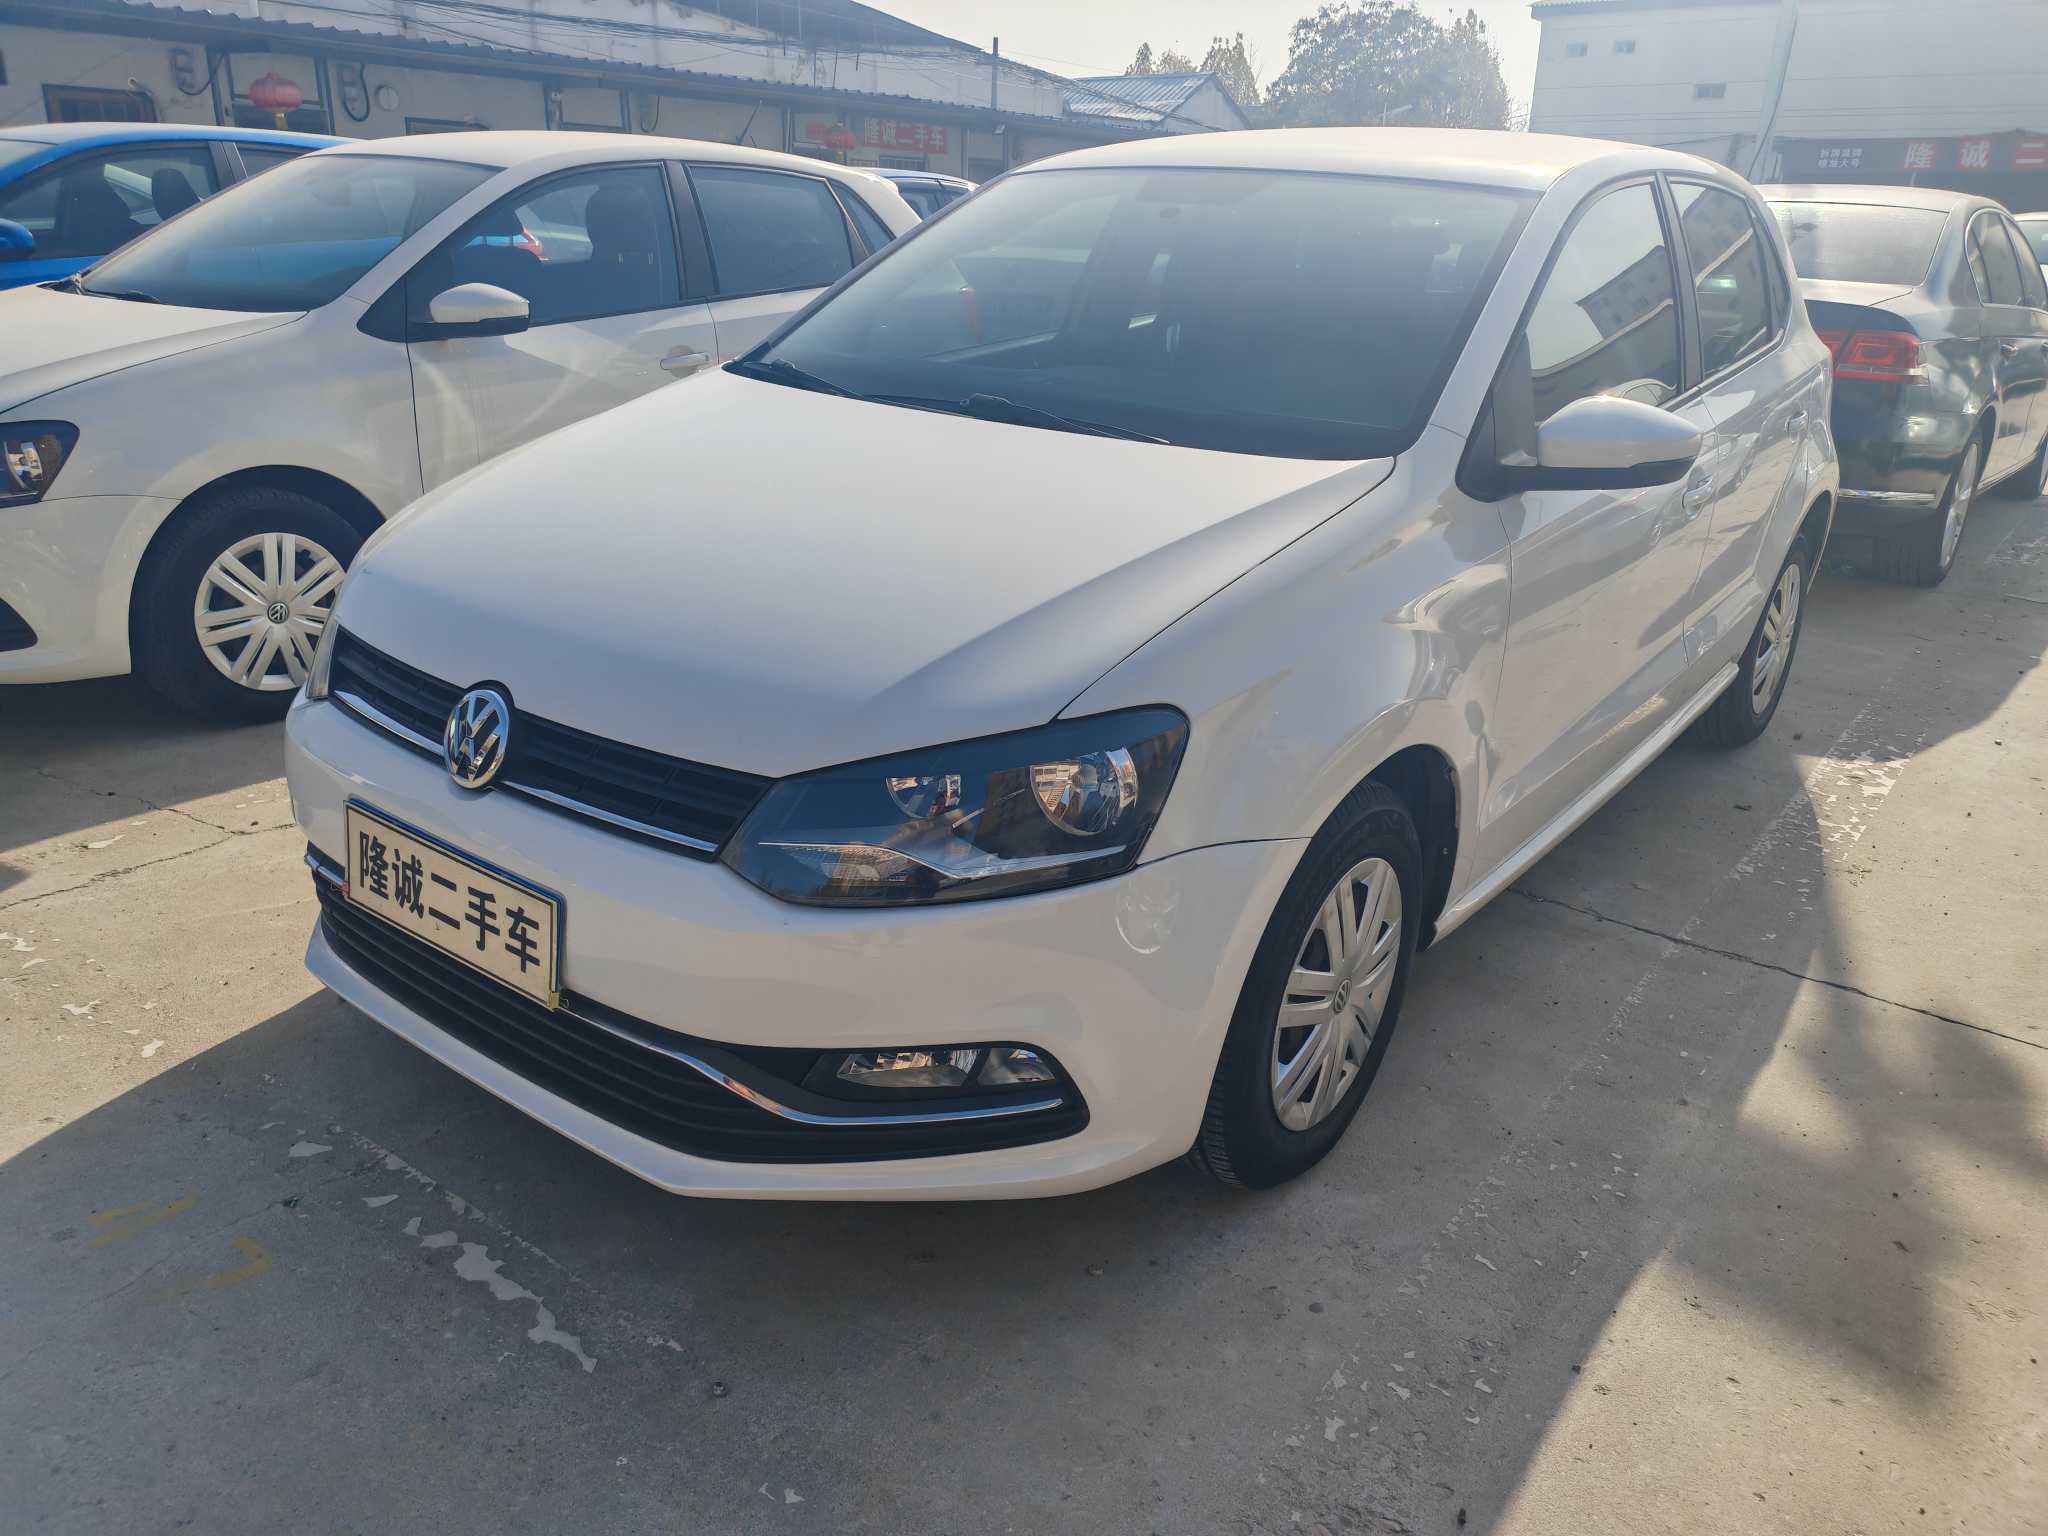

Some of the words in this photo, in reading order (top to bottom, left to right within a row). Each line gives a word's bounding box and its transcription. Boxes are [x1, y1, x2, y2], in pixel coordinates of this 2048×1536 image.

[1903, 141, 2046, 169] 隆诚二
[359, 831, 541, 973] 隆诚二手车
